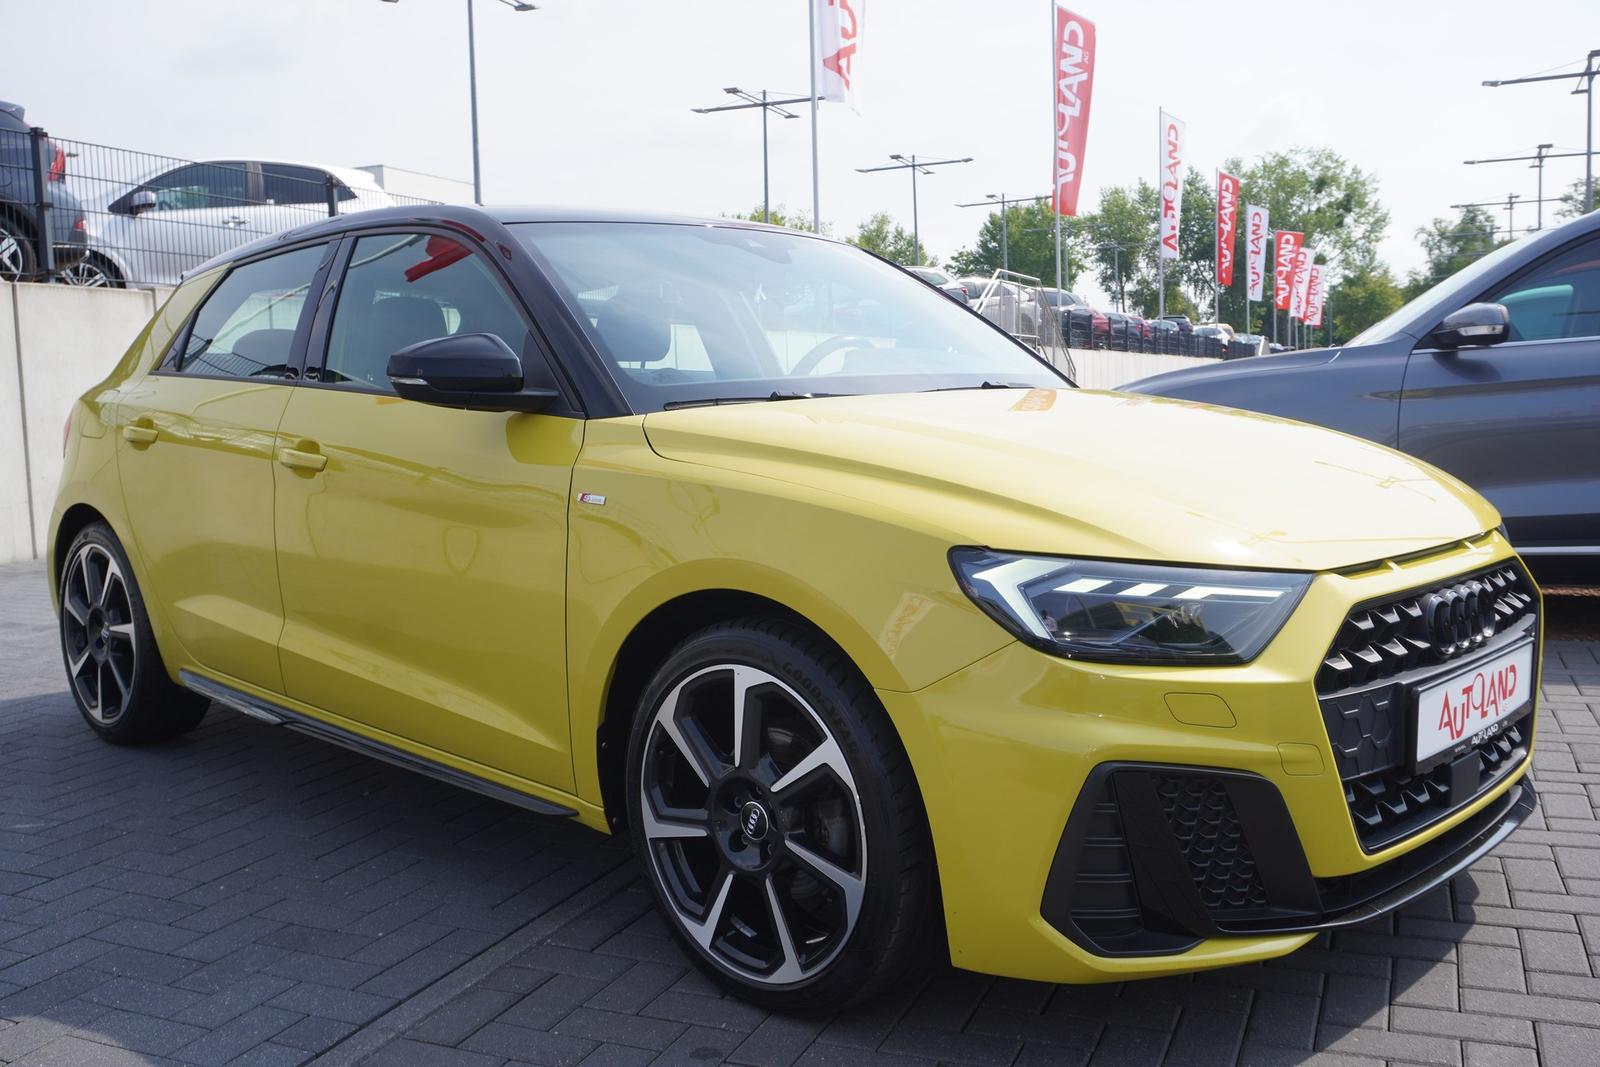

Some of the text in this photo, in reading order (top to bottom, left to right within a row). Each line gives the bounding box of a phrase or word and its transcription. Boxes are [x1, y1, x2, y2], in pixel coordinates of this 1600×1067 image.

[822, 0, 857, 92] AU
[1219, 178, 1234, 278] ULAND
[1249, 212, 1264, 296] AULAND
[1276, 234, 1296, 306] AUTOLAND
[1294, 252, 1307, 314] AULAND
[1438, 664, 1516, 740] AUTOLAND
